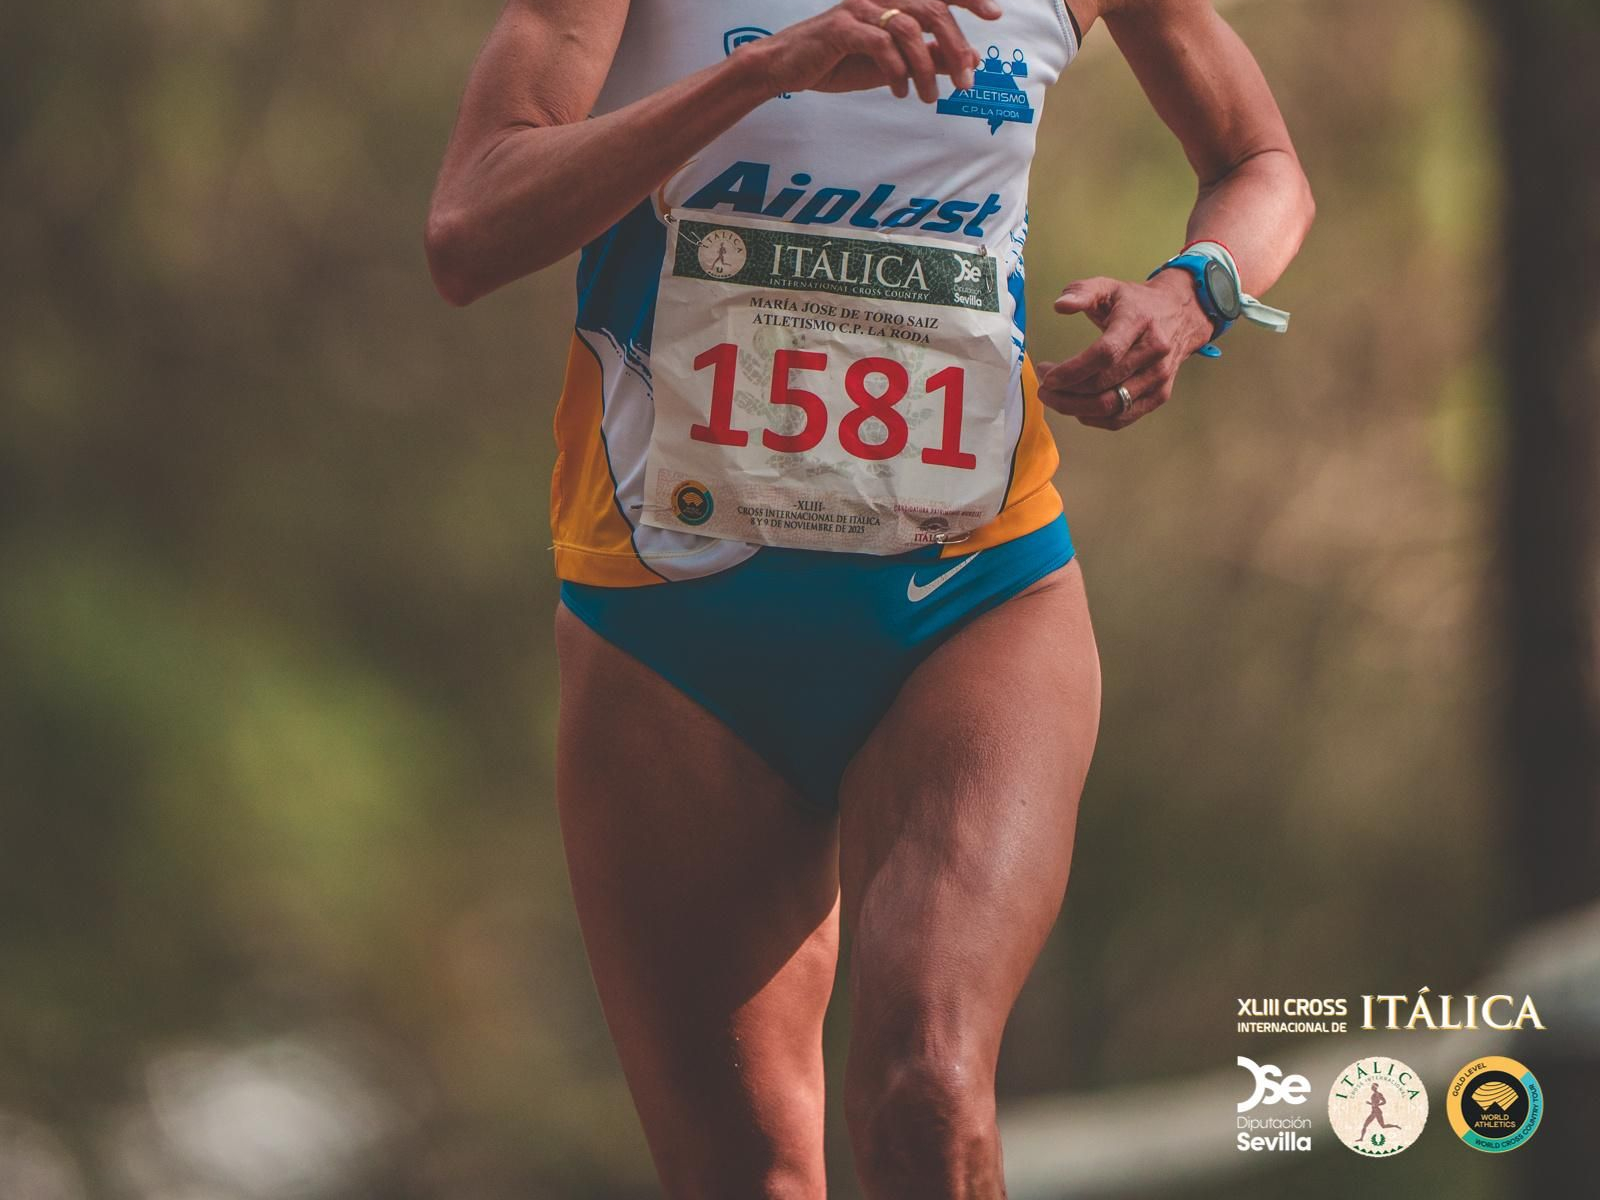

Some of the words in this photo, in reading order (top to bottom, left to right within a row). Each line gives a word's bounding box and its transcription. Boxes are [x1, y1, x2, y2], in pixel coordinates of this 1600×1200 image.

[958, 88, 1026, 104] ATLETISMO
[981, 107, 994, 116] LA
[681, 160, 1002, 238] Aiplast
[769, 240, 930, 291] ITÁLICA
[769, 278, 848, 293] INTERNATIONAL
[852, 286, 881, 296] CROSS
[884, 289, 930, 301] COUNTRY
[953, 292, 982, 307] Sevilla
[750, 297, 798, 312] MARÍA
[801, 302, 837, 317] JOSE
[840, 308, 861, 320] DE
[864, 311, 904, 326] TORO
[906, 315, 939, 329] SAIZ
[752, 313, 836, 332] ATLETISMO
[839, 323, 864, 335] C.P.
[868, 326, 886, 337] LA
[890, 328, 930, 344] RODA
[690, 343, 977, 471] 1581
[737, 505, 764, 517] CROSS
[765, 508, 835, 523] INTERNACIONAL
[836, 513, 848, 524] DE
[770, 519, 782, 529] DE
[783, 520, 834, 533] NOVIEMBRE
[835, 523, 847, 534] DE
